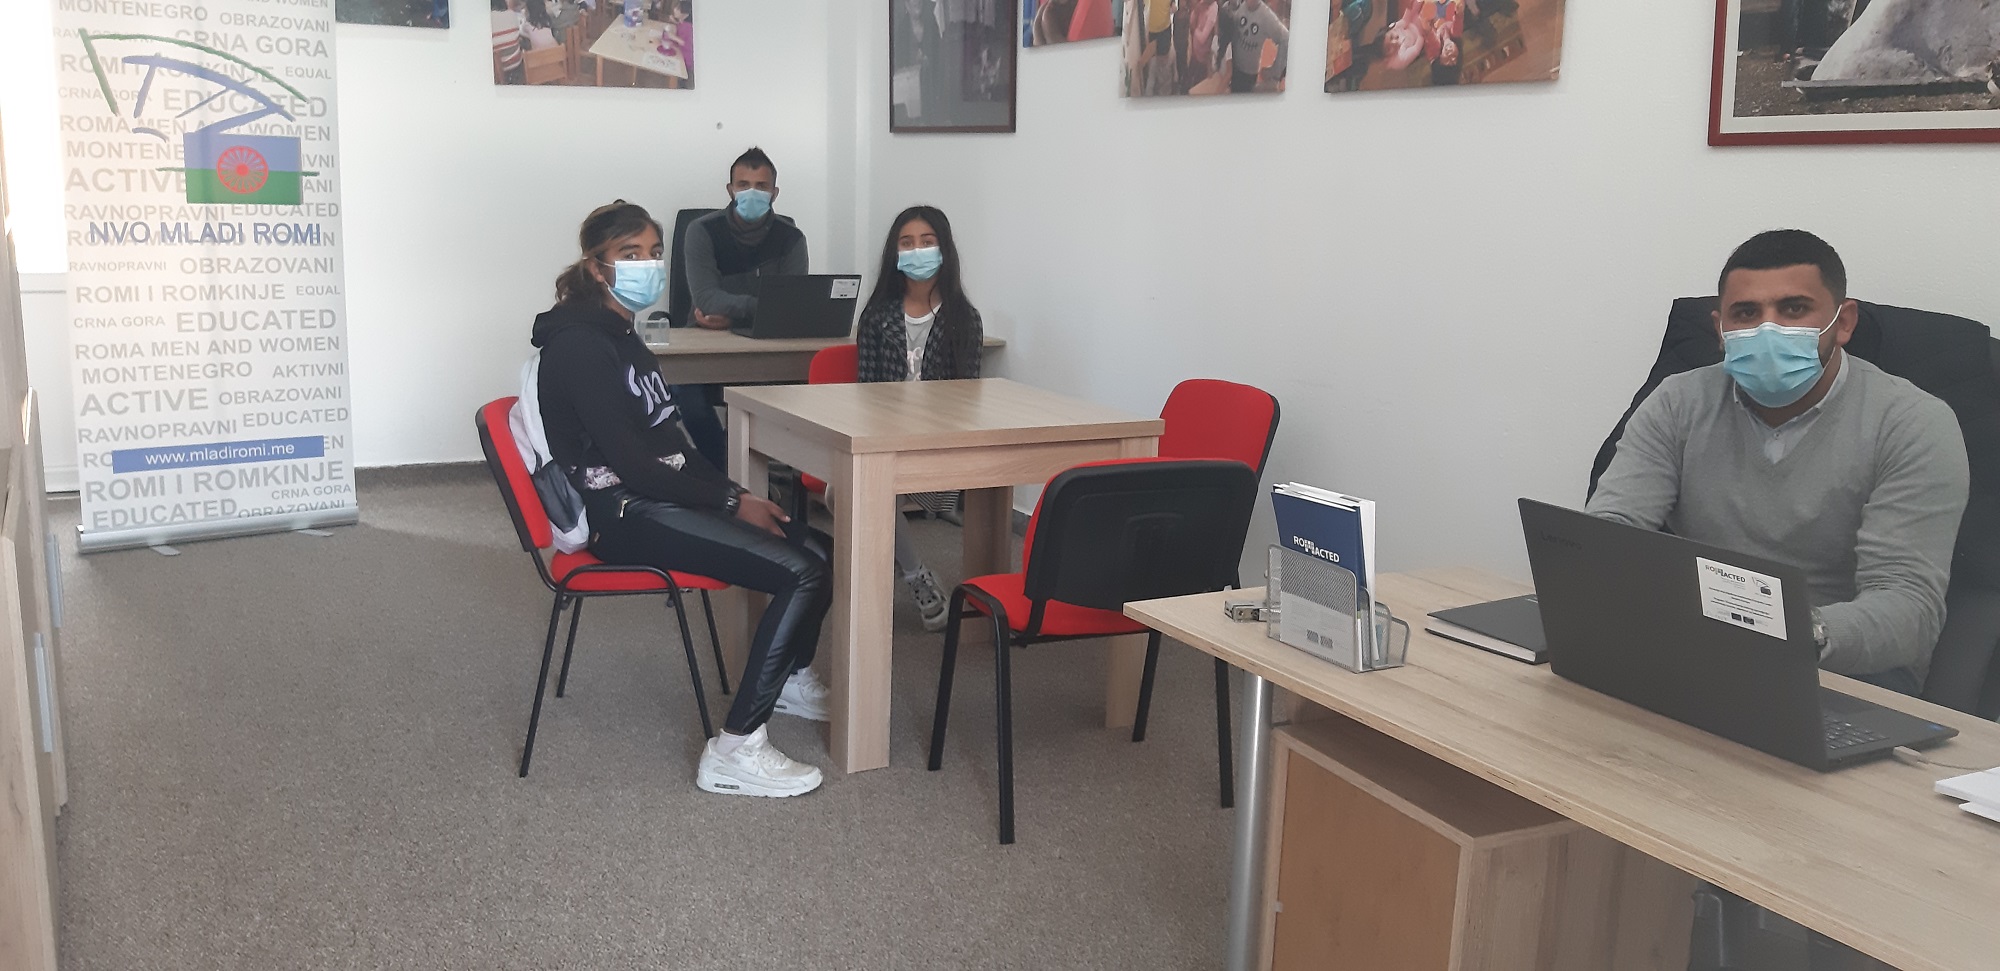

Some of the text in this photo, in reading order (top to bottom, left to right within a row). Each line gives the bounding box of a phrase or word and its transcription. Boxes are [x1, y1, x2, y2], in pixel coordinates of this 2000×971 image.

[59, 0, 208, 21] MONTENEGRO
[219, 12, 330, 33] OBRAZOVANI
[255, 35, 329, 58] GORA
[285, 66, 332, 80] EQUAL
[60, 115, 131, 134] ROMA
[249, 121, 331, 141] WOMEN
[64, 203, 225, 221] RAVNOPRAVNI
[231, 203, 340, 218] EDUCATED
[89, 221, 151, 244] NVO
[160, 222, 243, 244] MLADI
[253, 222, 321, 245] ROMI
[69, 260, 167, 273] RAVNOPRAVNI
[179, 256, 335, 275] OBRAZOVANI
[76, 284, 286, 303] ROMI I ROMKINJE
[296, 285, 341, 296] EQUAL
[74, 315, 166, 328] CRNA GORA
[176, 309, 337, 334] EDUCATED
[75, 336, 341, 360] ROMA MEN AND WOMEN
[82, 361, 253, 385] MONTENEGRO
[272, 362, 344, 379] AKTIVNI
[80, 387, 209, 417] ACTIVE
[218, 386, 342, 406] OBRAZOVANI
[243, 407, 349, 428] EDUCATED
[78, 419, 237, 444] RAVNOPRAVNI
[145, 443, 295, 465] www.mladiromi.me
[85, 460, 345, 503] ROMI I ROMKINJE
[271, 483, 352, 501] CRNA GORA
[92, 497, 238, 530] EDUCATED
